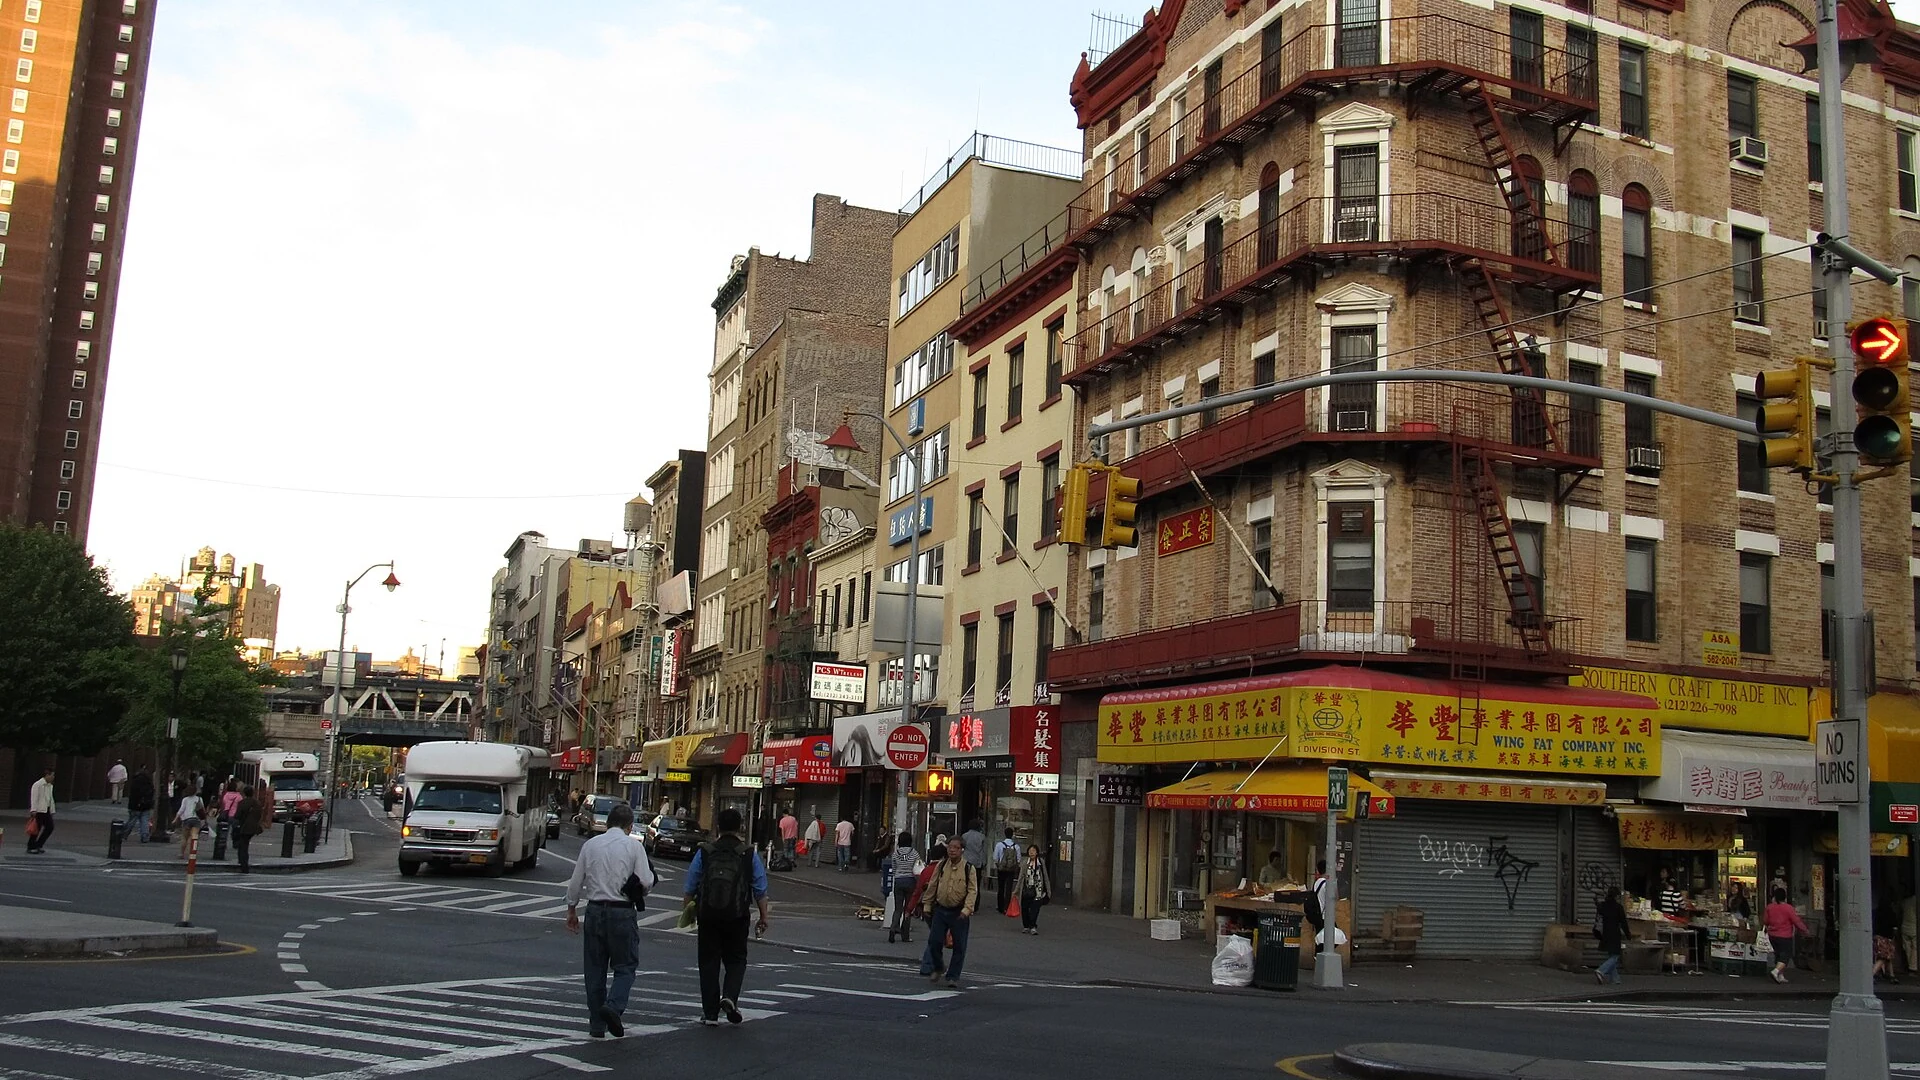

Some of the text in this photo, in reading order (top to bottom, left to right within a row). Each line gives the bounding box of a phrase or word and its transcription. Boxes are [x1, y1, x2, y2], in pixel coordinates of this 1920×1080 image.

[1711, 634, 1731, 645] ASA
[816, 666, 831, 674] PCS
[1582, 668, 1797, 706] SOUTHERN CRAFT TRADE INC.
[1313, 692, 1343, 707] 華豐
[893, 733, 922, 742] DO NOT
[1033, 710, 1052, 768] 名髮集
[1493, 735, 1645, 754] WING FAT COMPANY INC.
[1826, 732, 1843, 755] NO
[894, 752, 919, 761] ENTER
[1304, 745, 1344, 754] DIVISION
[1348, 748, 1361, 756] ST.
[1017, 774, 1044, 788] 名髮集
[1819, 760, 1855, 785] TURNS
[1690, 764, 1764, 801] 美麗屋
[1769, 770, 1811, 798] Beauty
